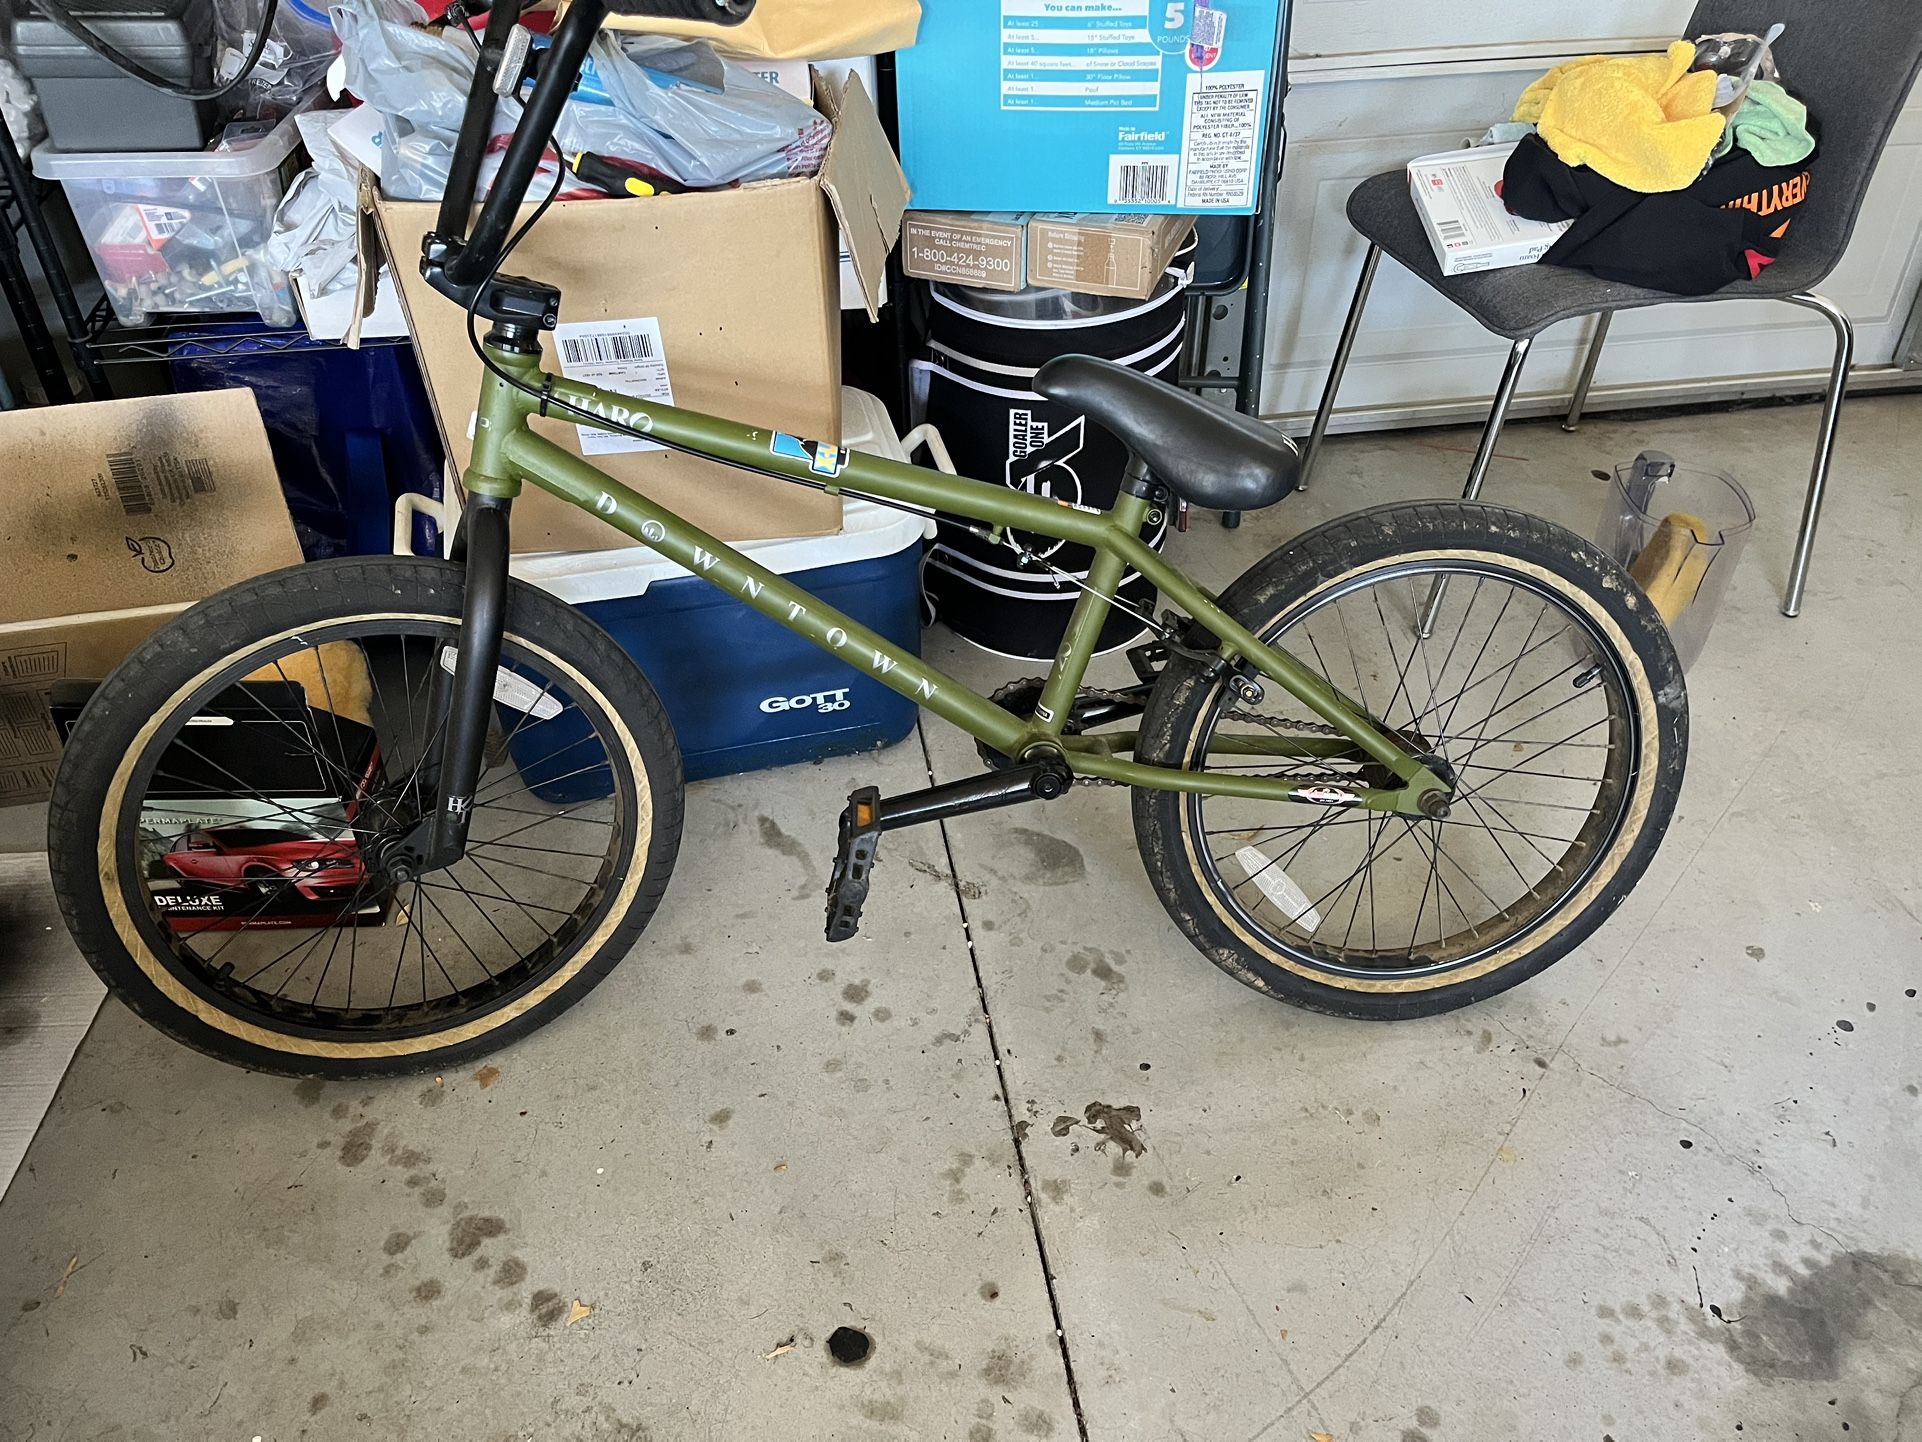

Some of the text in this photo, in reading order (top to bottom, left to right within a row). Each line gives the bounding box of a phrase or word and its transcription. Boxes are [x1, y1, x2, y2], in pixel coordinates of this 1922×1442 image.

[1044, 3, 1062, 12] You
[1085, 3, 1122, 11] make...
[1164, 3, 1184, 29] 5
[1157, 35, 1191, 43] POUNDS
[931, 230, 951, 239] EVENT
[972, 236, 1011, 247] EMERGENCY
[935, 238, 986, 251] CALL CHEMTREC
[912, 247, 1010, 272] 1-800-424-9300
[1013, 411, 1029, 459] GOALER
[1030, 423, 1045, 448] ONE
[759, 687, 850, 714] GOTT
[817, 699, 851, 713] 30
[154, 896, 223, 905] DELUXE
